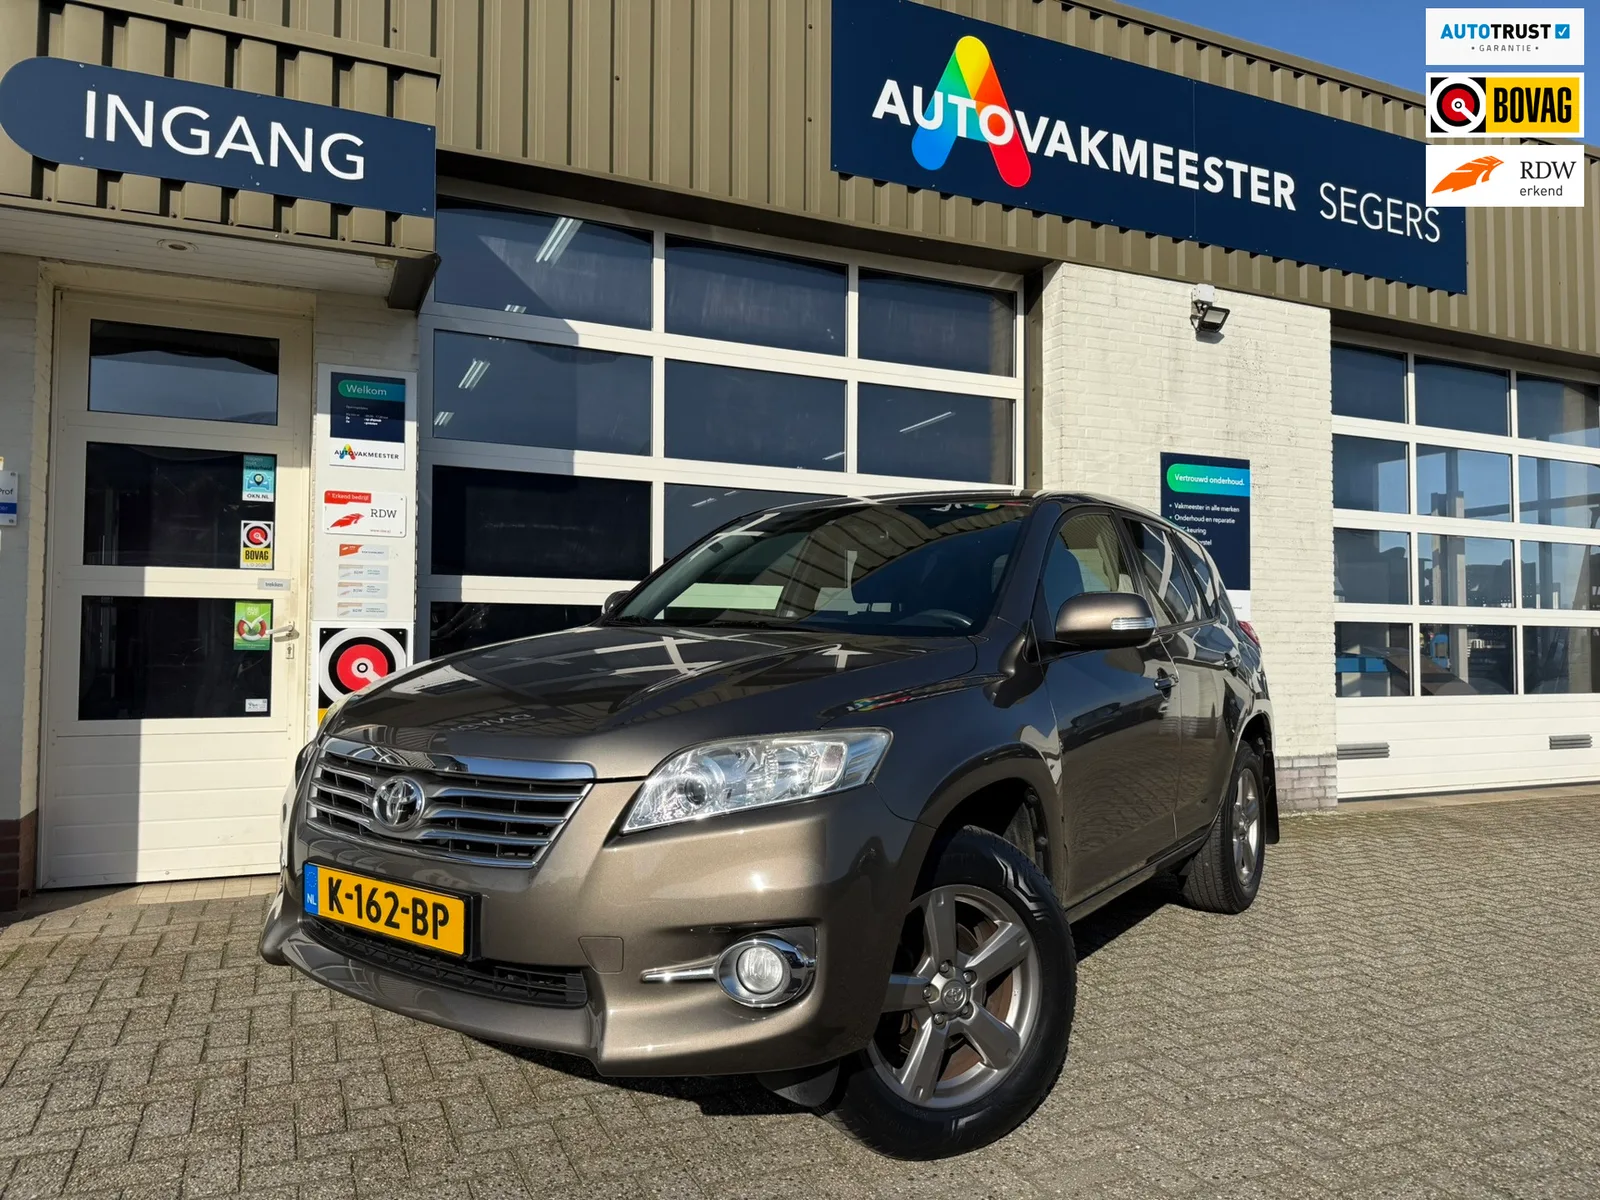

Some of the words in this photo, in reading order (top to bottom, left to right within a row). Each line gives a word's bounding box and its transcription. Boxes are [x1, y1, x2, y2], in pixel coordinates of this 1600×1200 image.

[85, 90, 365, 181] INGANG
[872, 78, 1296, 211] AUTOVAKMEESTER
[1319, 181, 1441, 243] SEGERS
[346, 384, 387, 396] Welkom
[334, 449, 399, 460] AUTOVAKMEESTER
[1174, 473, 1209, 483] Vertrouwd
[1209, 475, 1245, 486] onderhoud.
[370, 508, 397, 518] RDW
[1173, 502, 1205, 511] Vakmeester
[1221, 505, 1240, 513] merken
[1174, 513, 1205, 522] Onderhoud
[1213, 516, 1236, 525] reparatie
[245, 550, 269, 561] BOVAG
[306, 893, 317, 906] NL
[328, 876, 450, 940] K-162-BP
